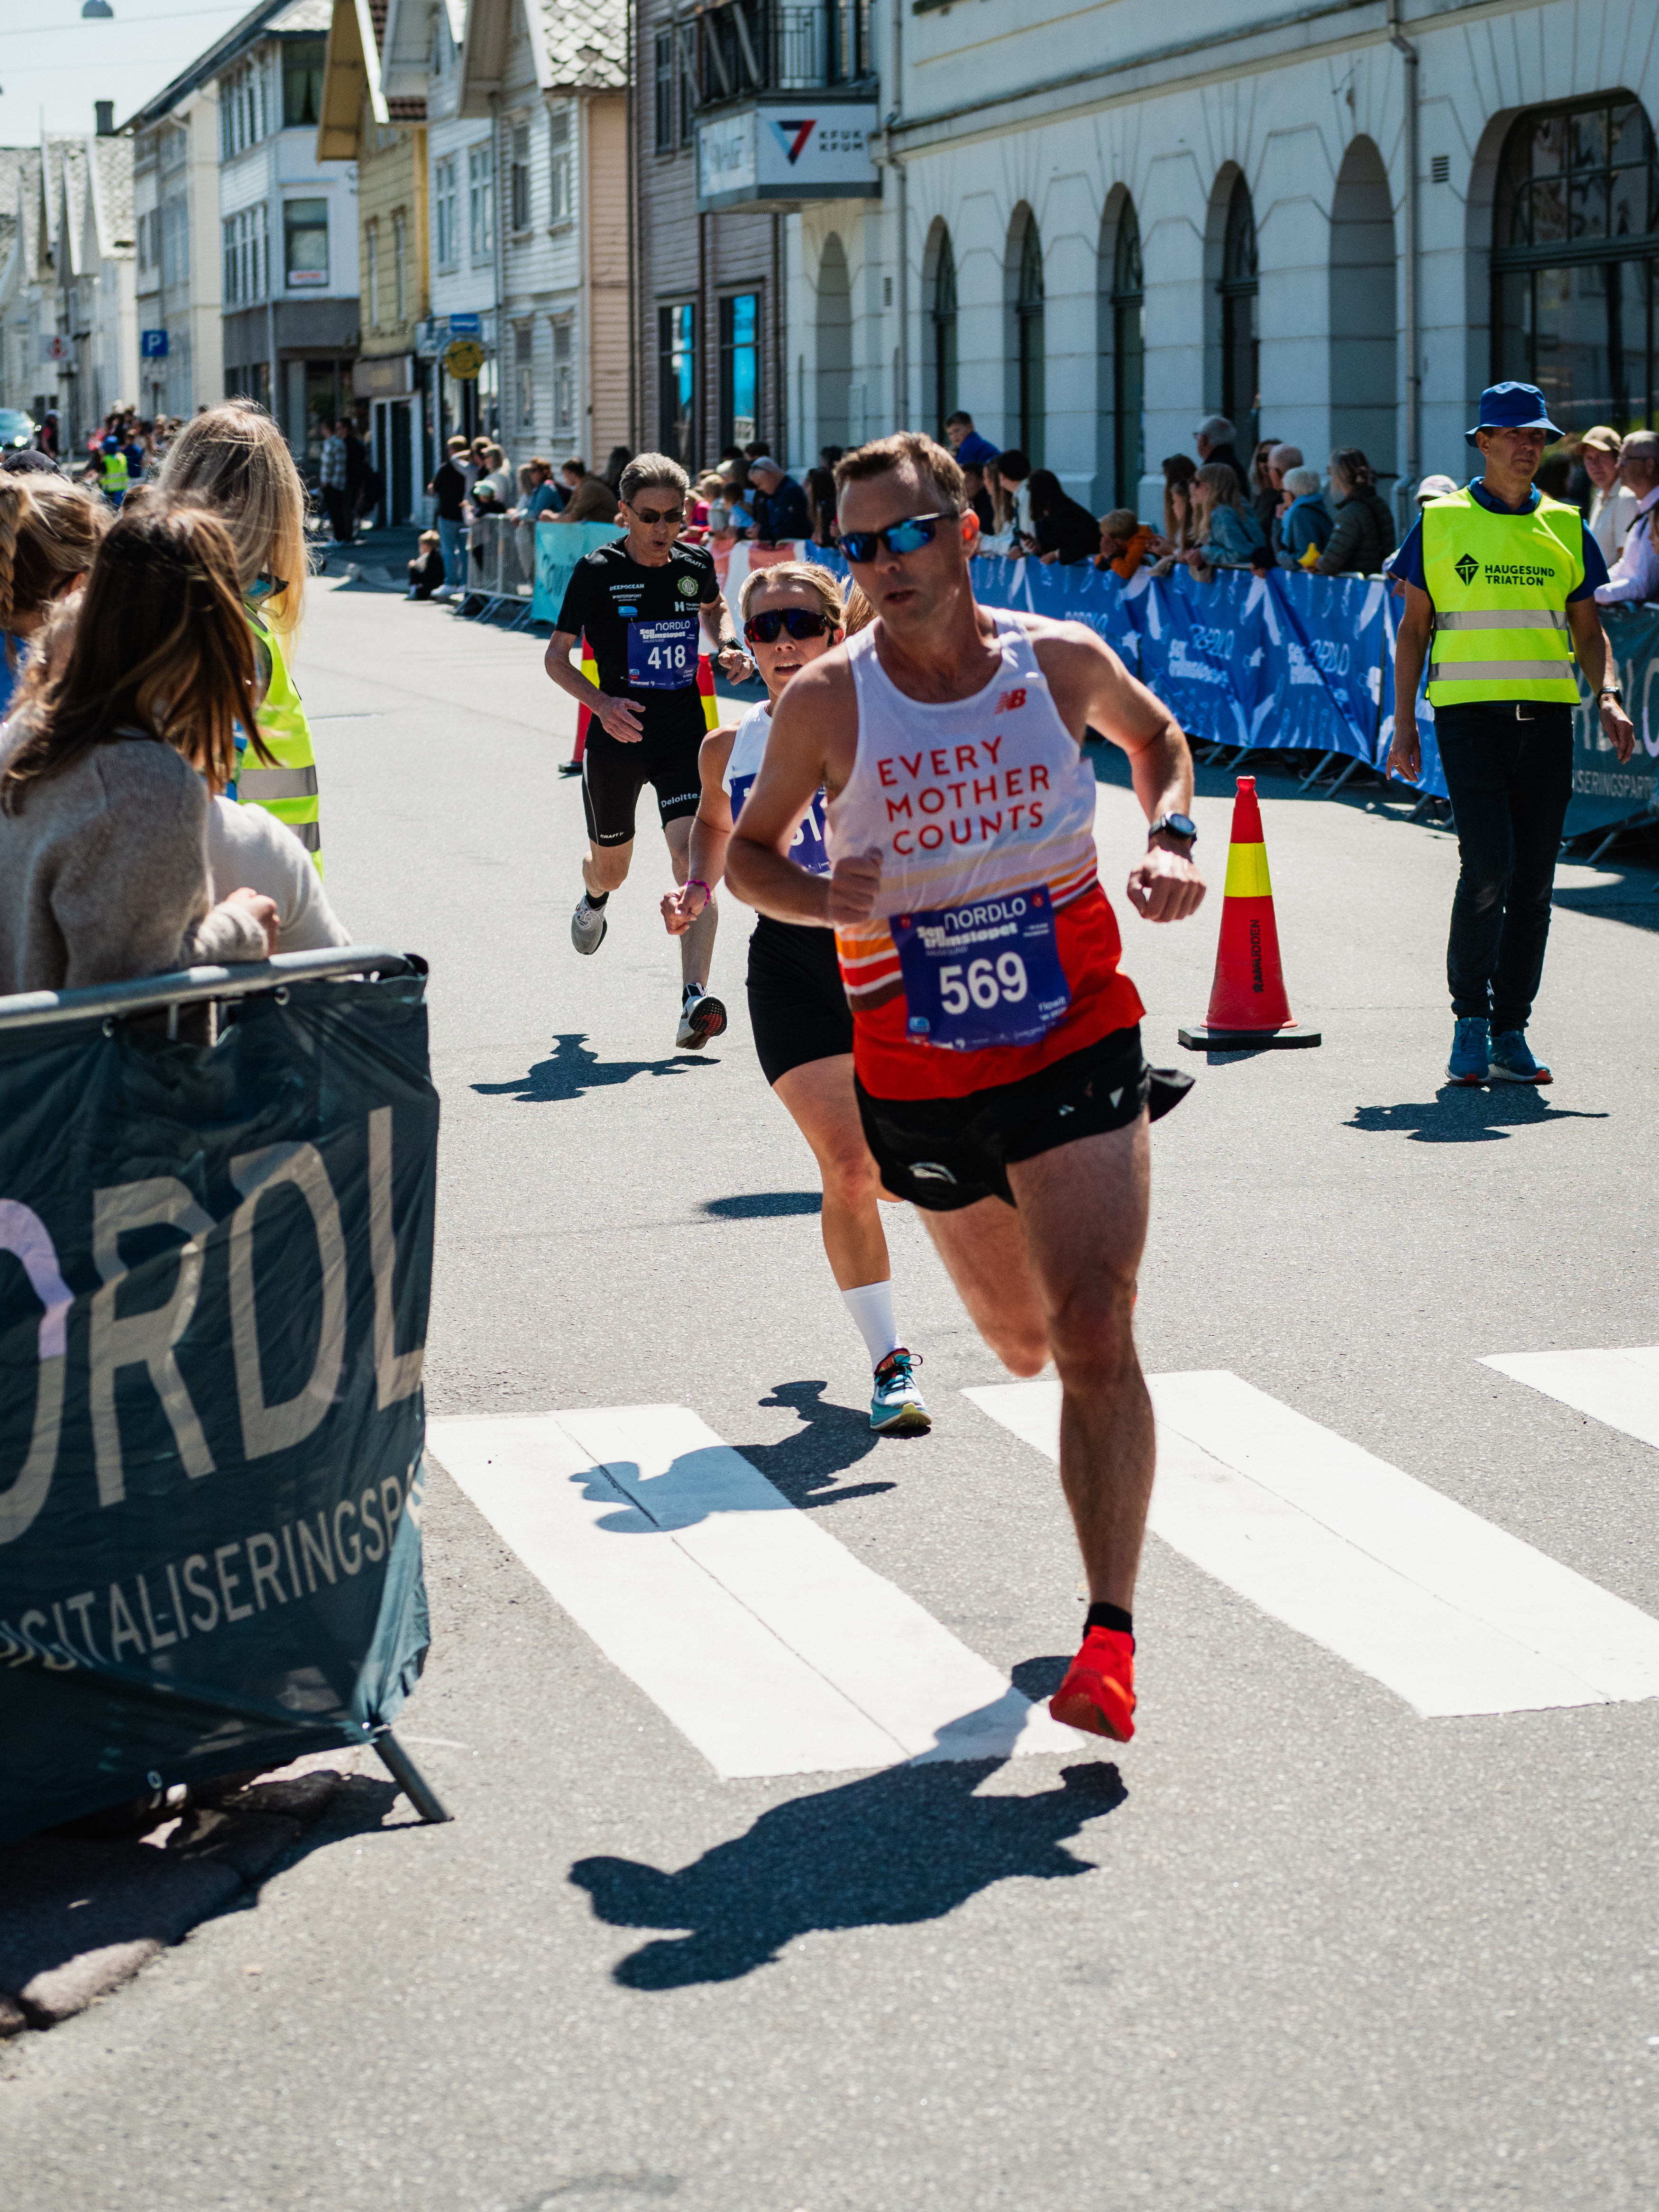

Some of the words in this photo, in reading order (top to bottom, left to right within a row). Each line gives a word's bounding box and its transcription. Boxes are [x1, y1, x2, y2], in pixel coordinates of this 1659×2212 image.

[819, 130, 862, 139] KFUK
[819, 142, 863, 152] KFUM
[148, 334, 162, 352] P
[684, 556, 702, 567] CRAFT
[1485, 565, 1555, 577] HAUGESUND
[1485, 575, 1544, 586] TRIATLON
[648, 644, 686, 669] 418
[877, 735, 1003, 788] EVERY
[885, 764, 1050, 823] MOTHER
[892, 801, 1044, 855] COUNTS
[1250, 918, 1264, 993] RAMUDDEN
[939, 951, 1028, 1016] 569
